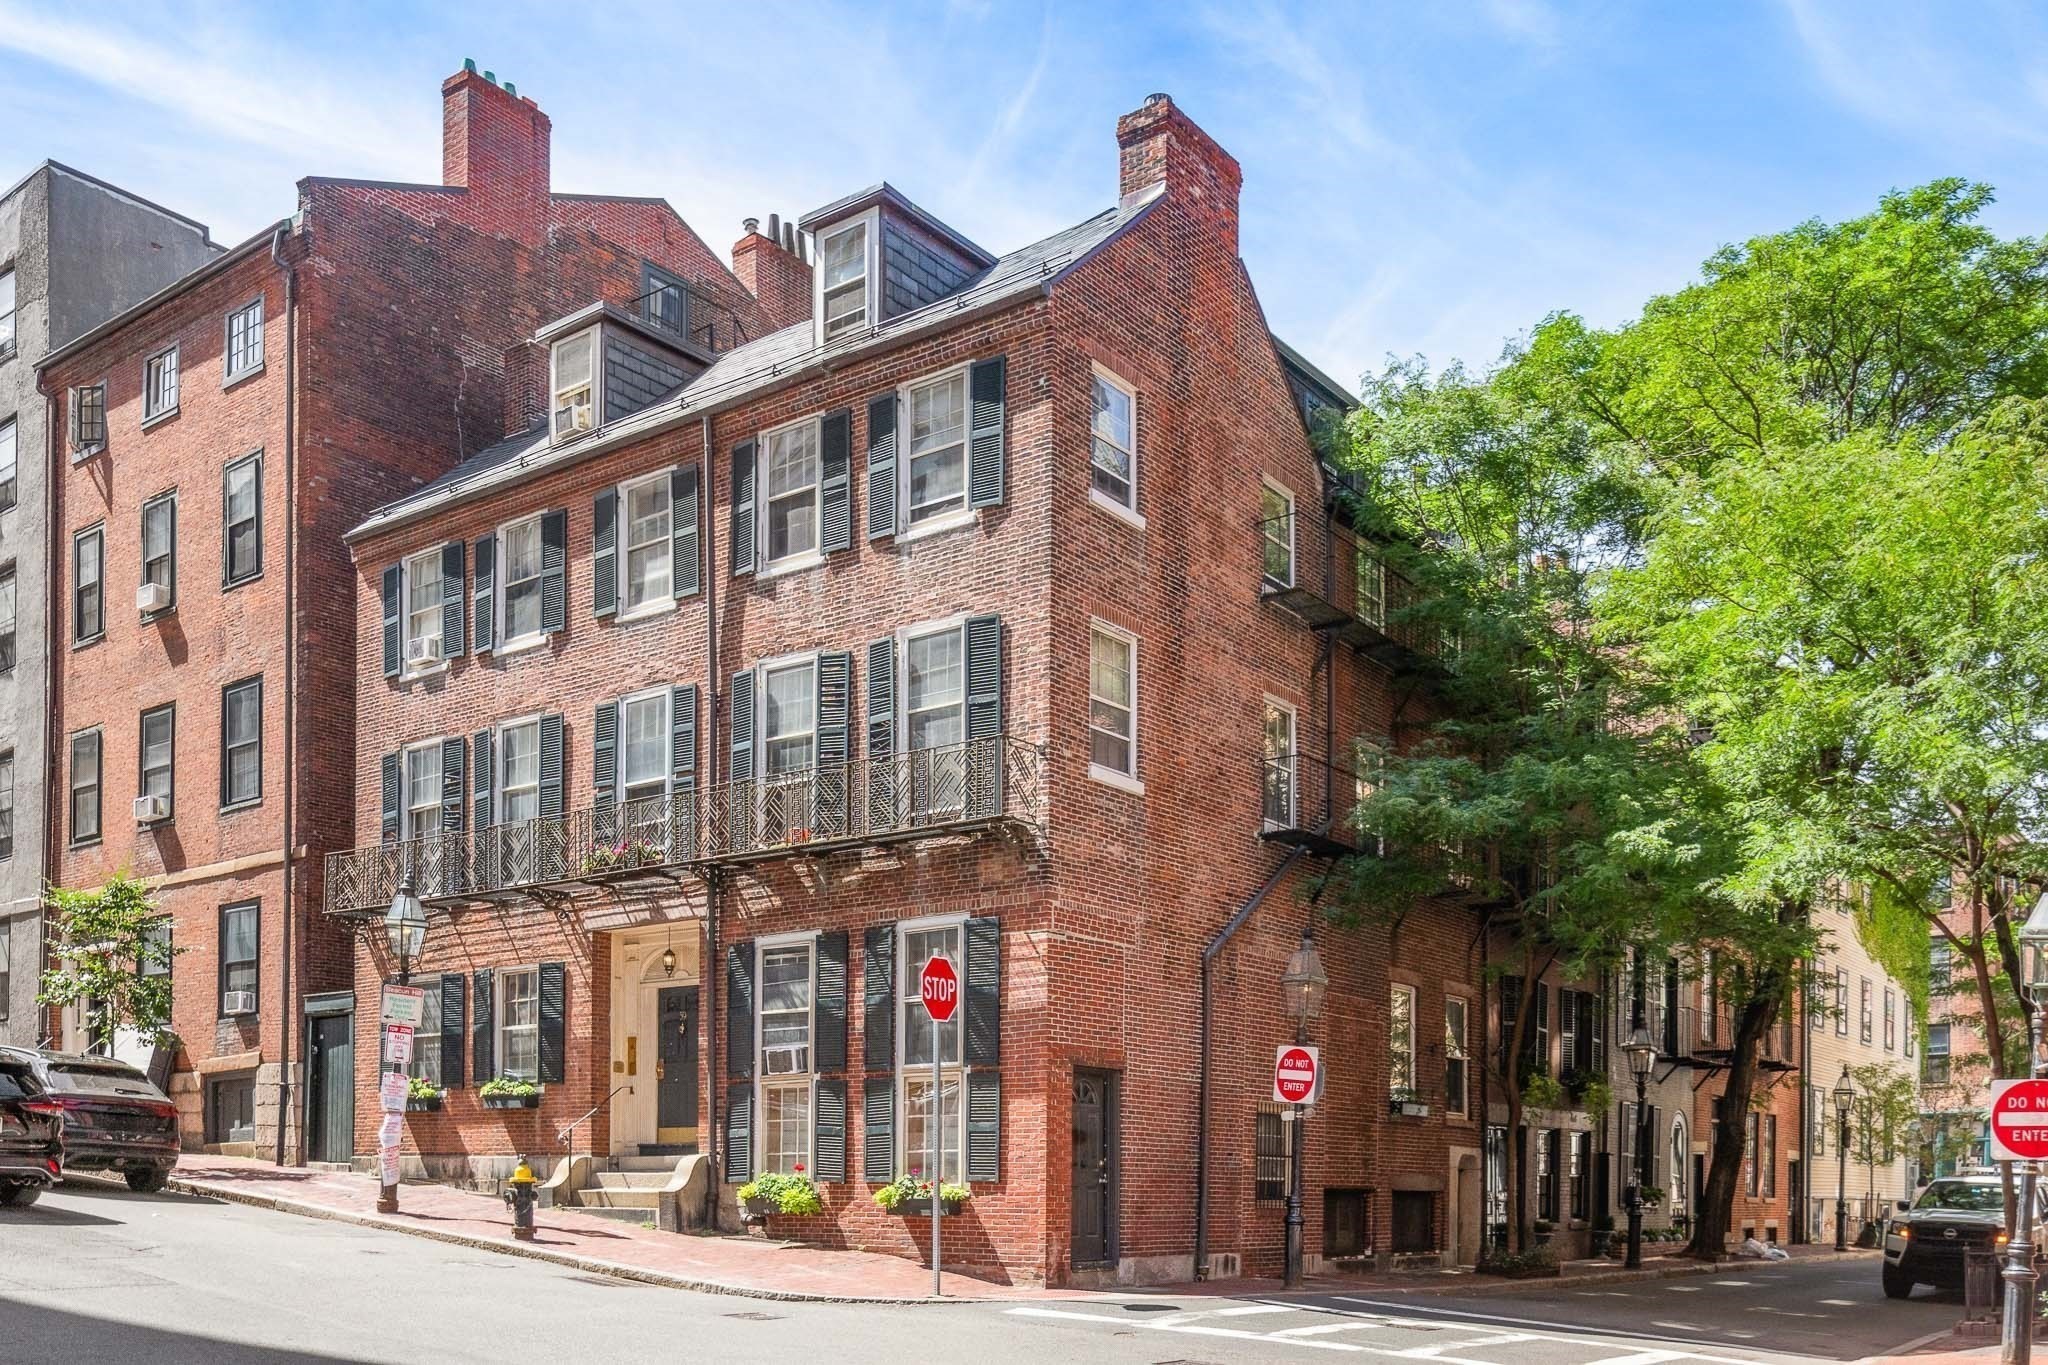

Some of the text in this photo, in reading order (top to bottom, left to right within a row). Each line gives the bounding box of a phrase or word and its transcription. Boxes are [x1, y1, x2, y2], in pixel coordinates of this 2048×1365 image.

[924, 976, 955, 1002] STOP
[1284, 1058, 1309, 1068] DO NOT
[1283, 1082, 1304, 1092] ENTER
[2007, 1096, 2028, 1108] DO
[2012, 1129, 2048, 1142] ENTE
